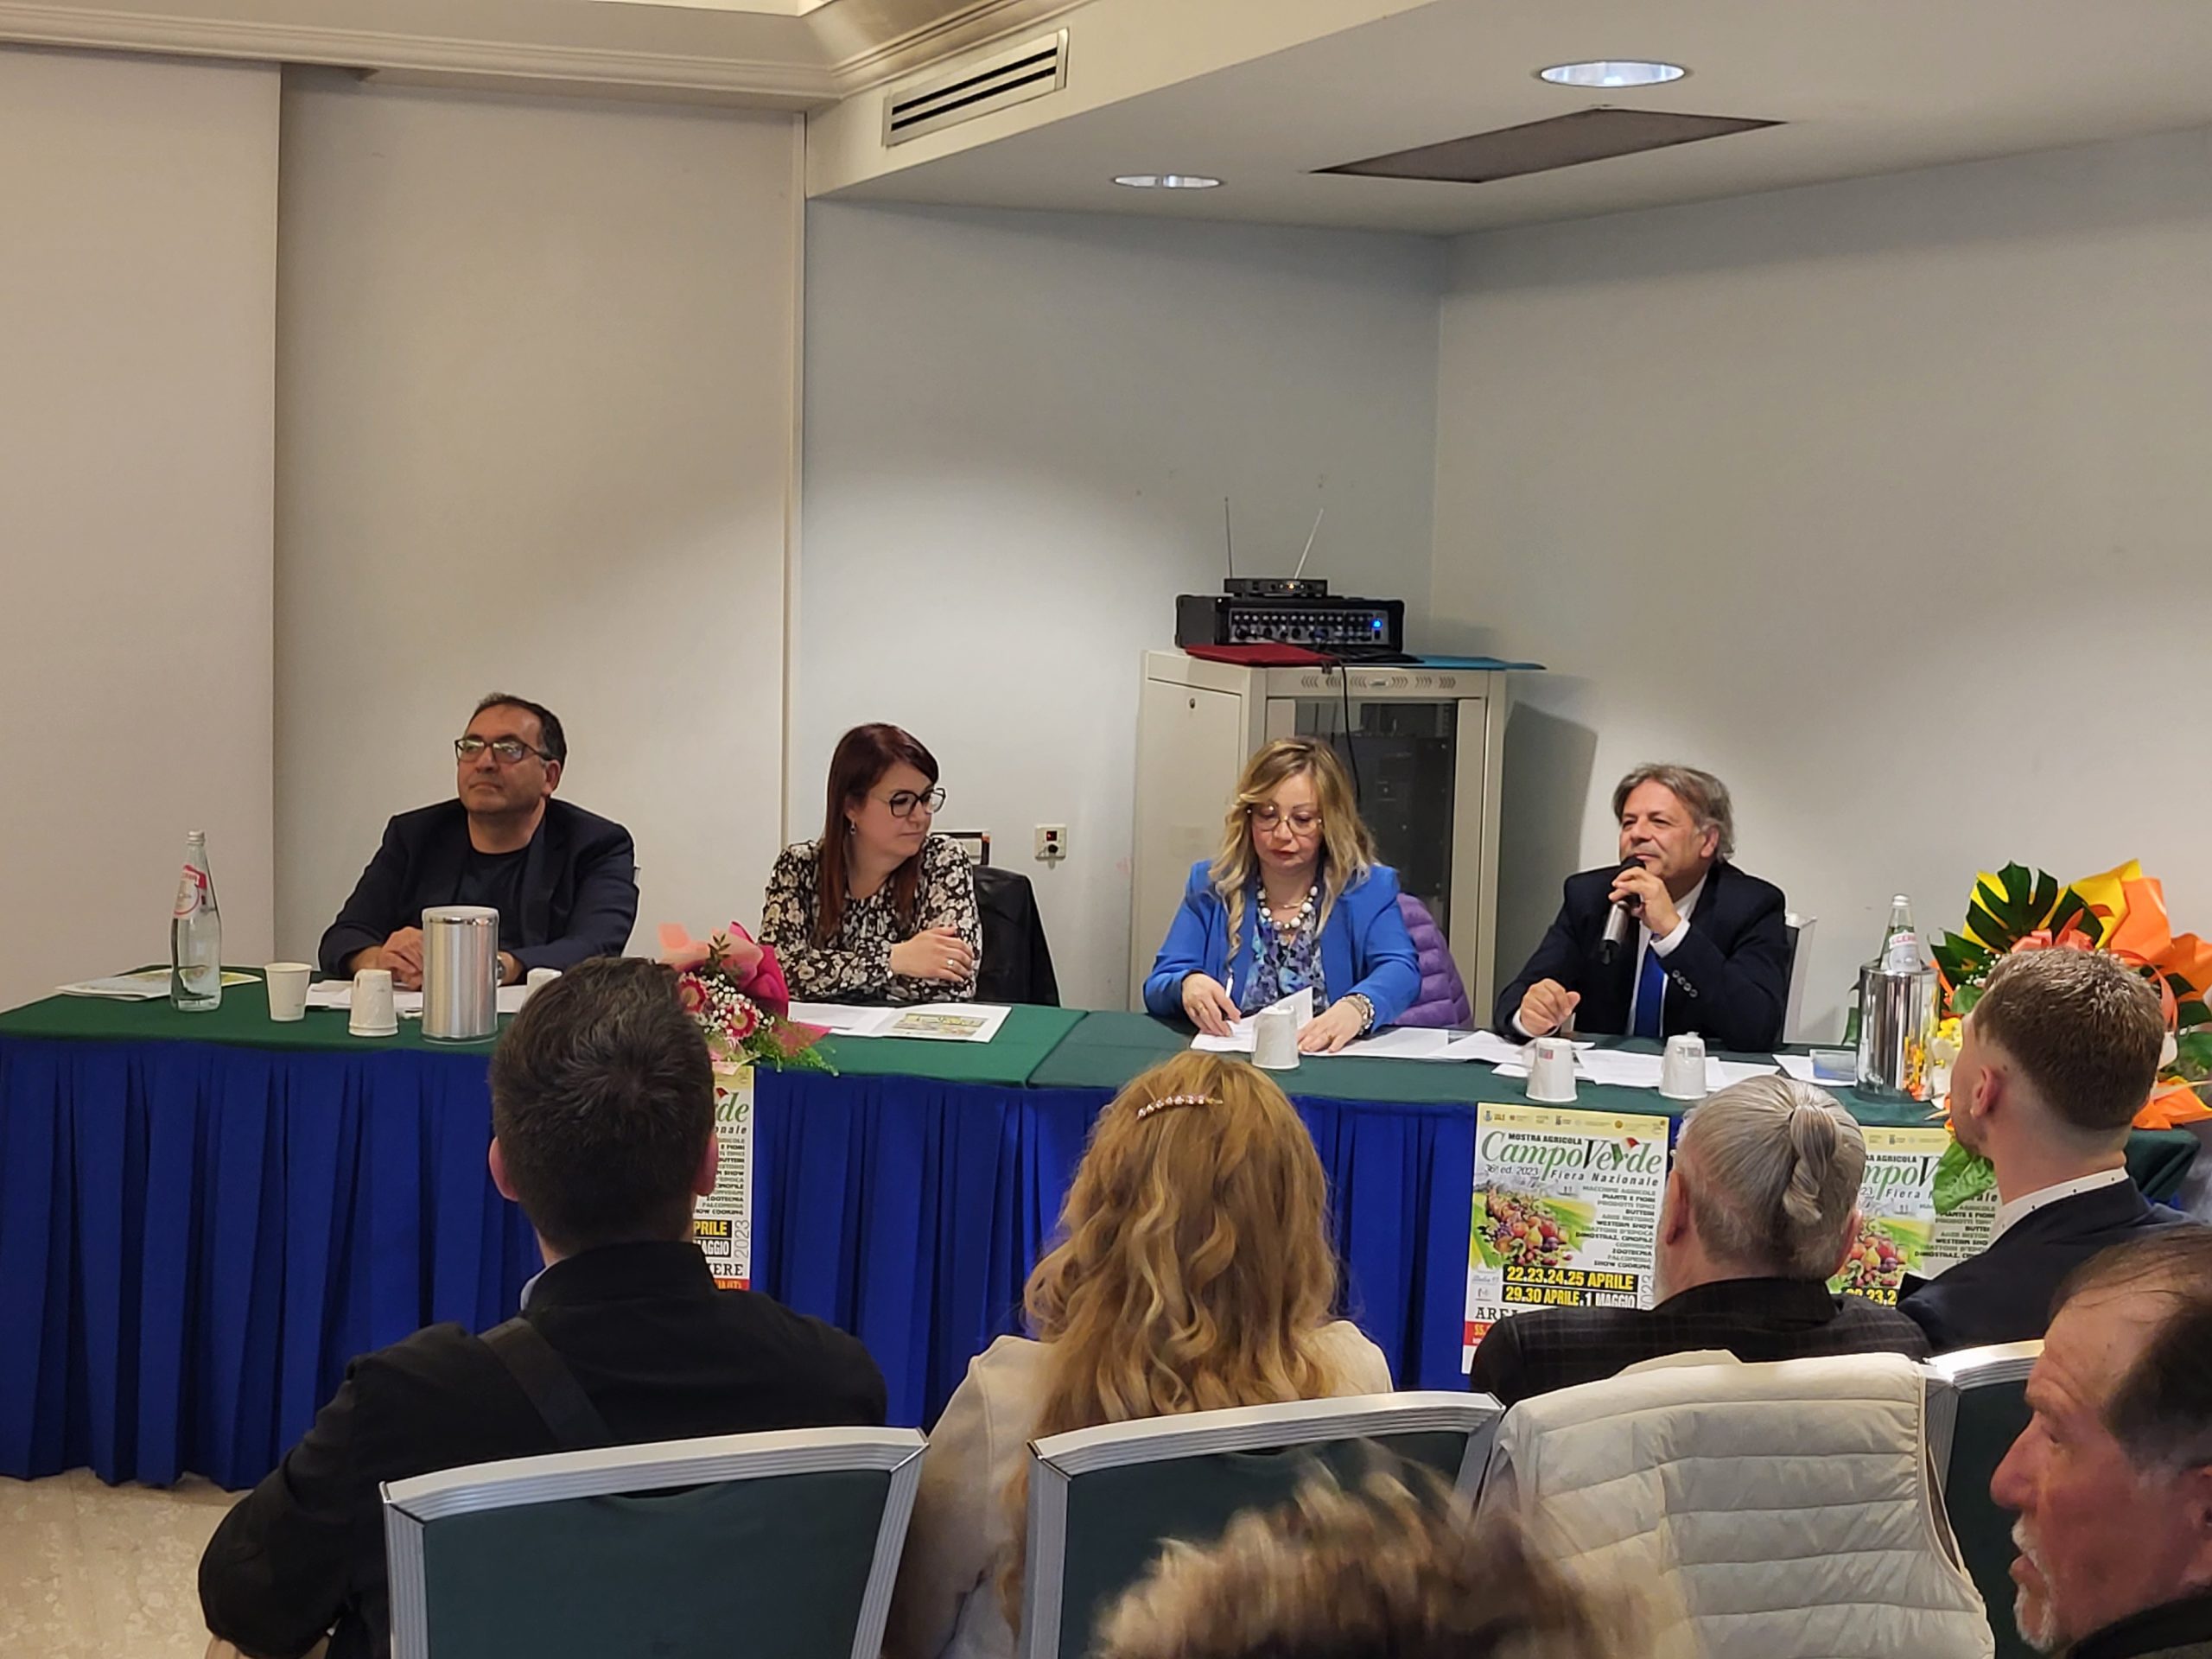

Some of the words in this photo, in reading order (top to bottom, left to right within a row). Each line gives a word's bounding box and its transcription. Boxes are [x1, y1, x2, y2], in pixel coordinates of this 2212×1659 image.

[1508, 1133, 1541, 1142] MOSTRA
[1542, 1135, 1582, 1145] AGRICOLA
[1481, 1131, 1662, 1181] CampoVerde
[1516, 1166, 1539, 1176] 2023
[1550, 1169, 1585, 1180] Fiera
[1591, 1173, 1659, 1186] Nazionale
[1885, 1188, 1920, 1198] Fiera
[693, 1220, 728, 1236] PRILE
[734, 1219, 749, 1258] 2023
[701, 1240, 729, 1255] AGGIO
[1506, 1266, 1585, 1287] 22.23.24.25
[1586, 1274, 1634, 1290] APRILE
[1505, 1286, 1542, 1303] 29.30
[1595, 1292, 1636, 1307] MAGGIO
